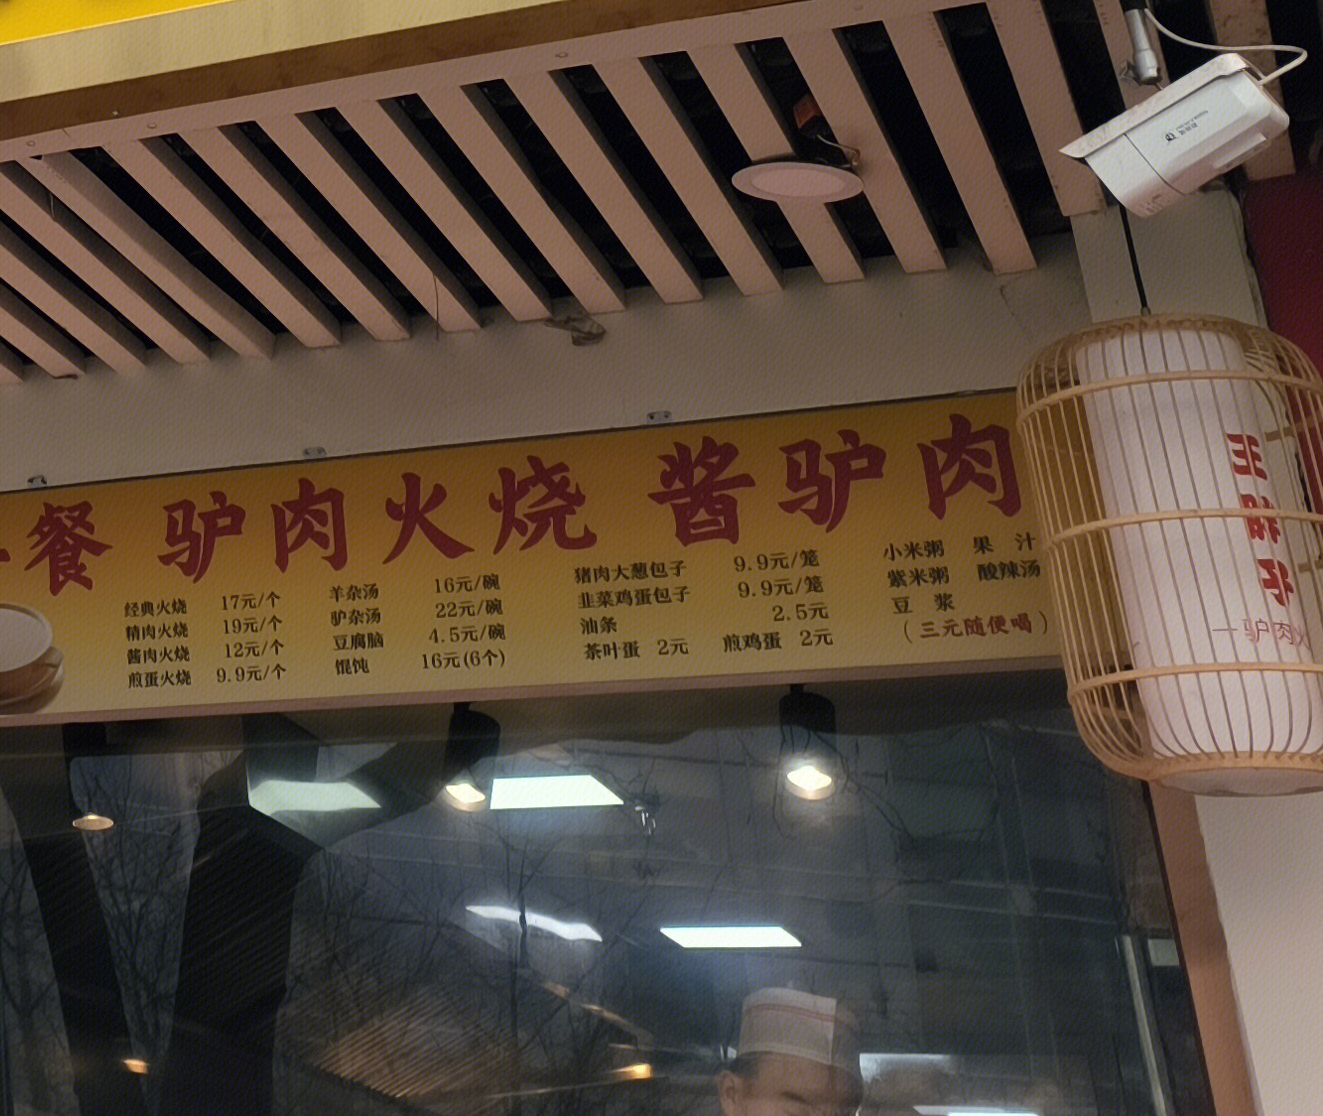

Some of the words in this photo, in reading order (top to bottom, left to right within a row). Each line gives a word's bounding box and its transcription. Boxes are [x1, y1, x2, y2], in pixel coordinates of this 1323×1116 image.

[157, 455, 597, 584] 驴肉火烧
[647, 414, 1023, 547] 酱驴肉
[883, 539, 945, 562] 小米粥
[574, 560, 687, 585] 猪肉大葱包子
[734, 549, 821, 573] 9.9元/笼
[977, 558, 1041, 582] 酸辣汤
[329, 583, 379, 603] 羊杂汤
[433, 573, 500, 595] 16元/碗
[578, 585, 691, 610] 韭菜鸡蛋包子
[737, 575, 825, 599] 9.9元/笼
[124, 598, 187, 619] 经典火烧
[221, 590, 281, 612] 17元/个
[330, 607, 381, 627] 驴杂汤
[435, 598, 504, 619] 22元/碗
[580, 616, 618, 635] 油条
[771, 601, 830, 623] 2.5元
[125, 622, 189, 641] 精肉火烧
[222, 614, 283, 635] 19元/个
[333, 631, 384, 651] 豆腐脑
[428, 623, 506, 645] 4.5元/碗
[126, 645, 190, 665] 酱肉火烧
[224, 639, 285, 660] 12元/个
[583, 640, 640, 661] 茶叶蛋
[657, 636, 690, 657] 2元
[722, 631, 783, 654] 煎鸡蛋
[799, 627, 835, 647] 2元
[127, 669, 192, 690] 煎蛋火烧
[216, 662, 287, 684] 9.9元/个
